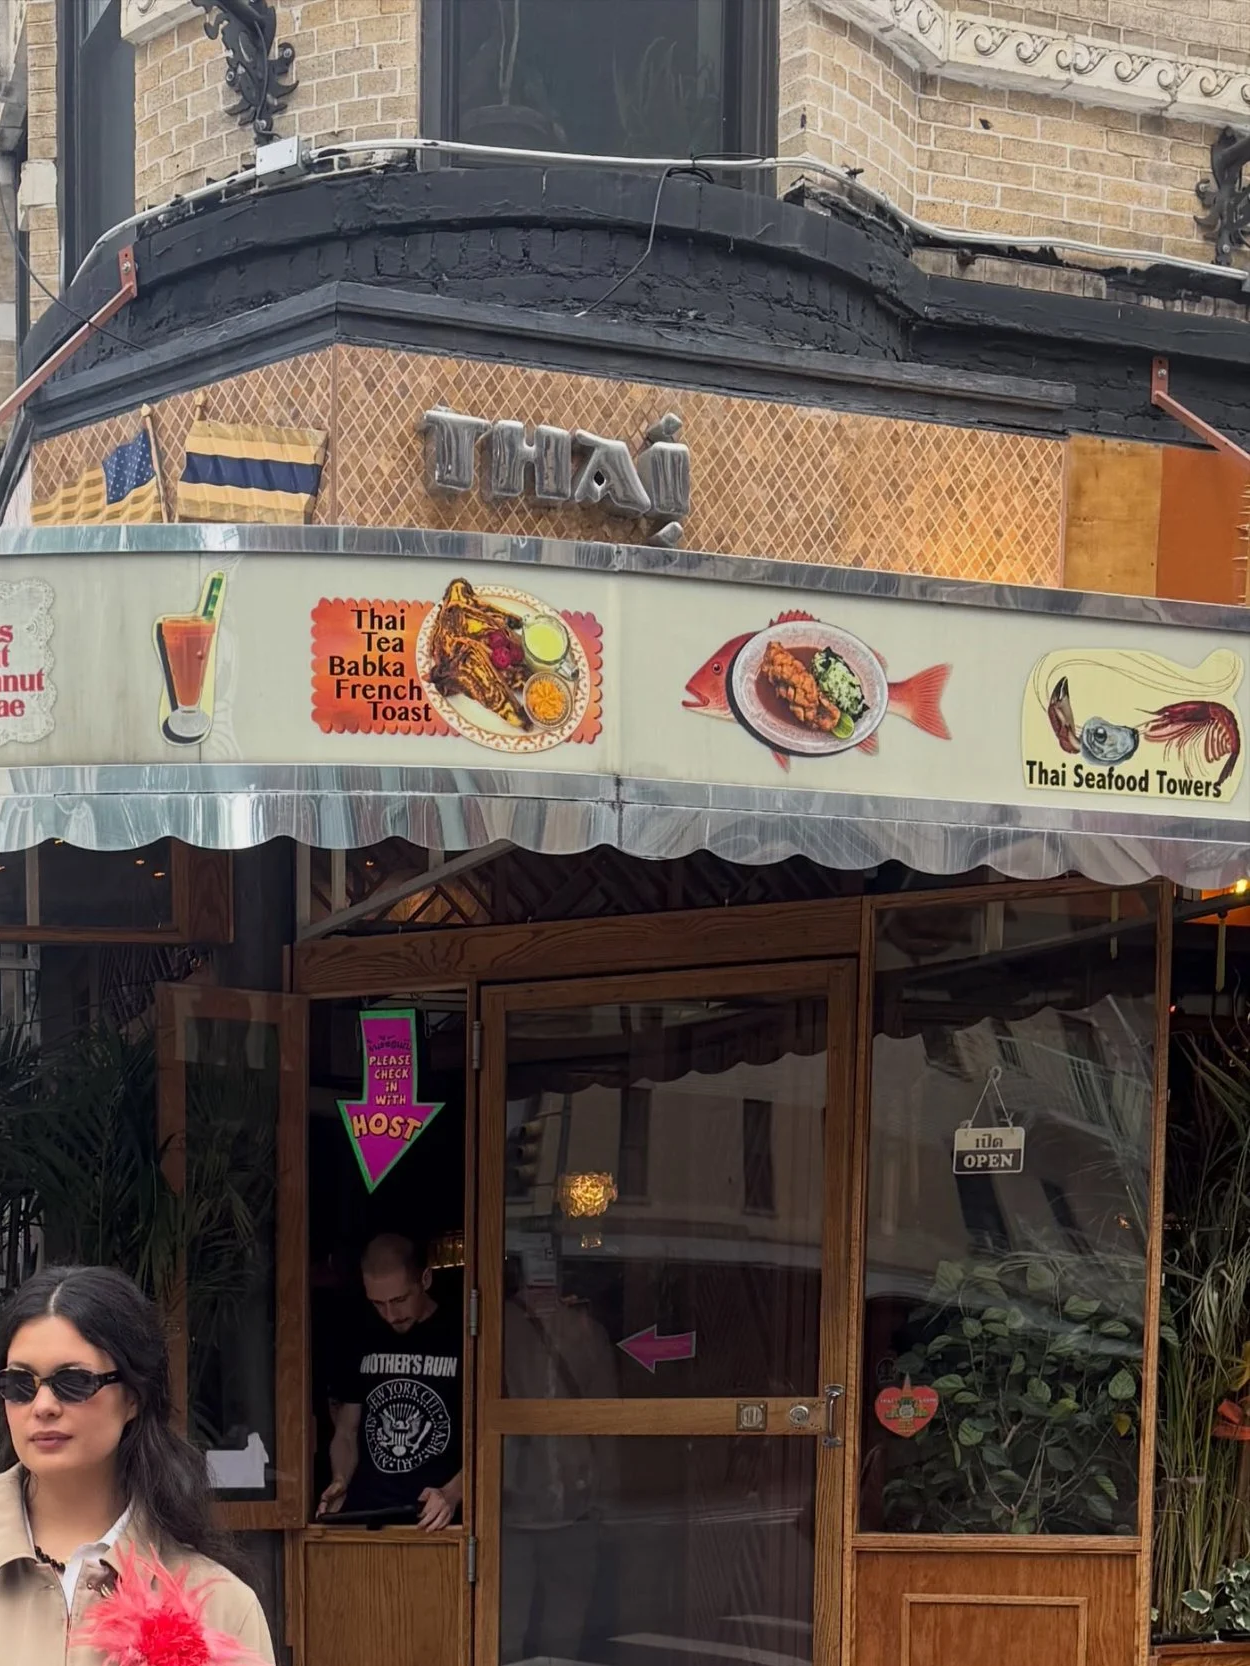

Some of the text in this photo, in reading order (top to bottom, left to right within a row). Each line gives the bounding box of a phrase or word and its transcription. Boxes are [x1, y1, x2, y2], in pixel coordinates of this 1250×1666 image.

[350, 608, 405, 630] Thai
[361, 631, 405, 653] Tea
[329, 654, 405, 677] Babka
[335, 678, 422, 701] French
[367, 700, 432, 722] Toast
[1026, 759, 1222, 798] Thai Seafood Towers
[369, 1055, 411, 1066] PLEASE
[374, 1068, 409, 1080] CHECK
[352, 1113, 423, 1140] HOST
[963, 1153, 1014, 1168] OPEN
[359, 1352, 458, 1377] MOTHER'S RUIN
[386, 1381, 421, 1398] YORK
